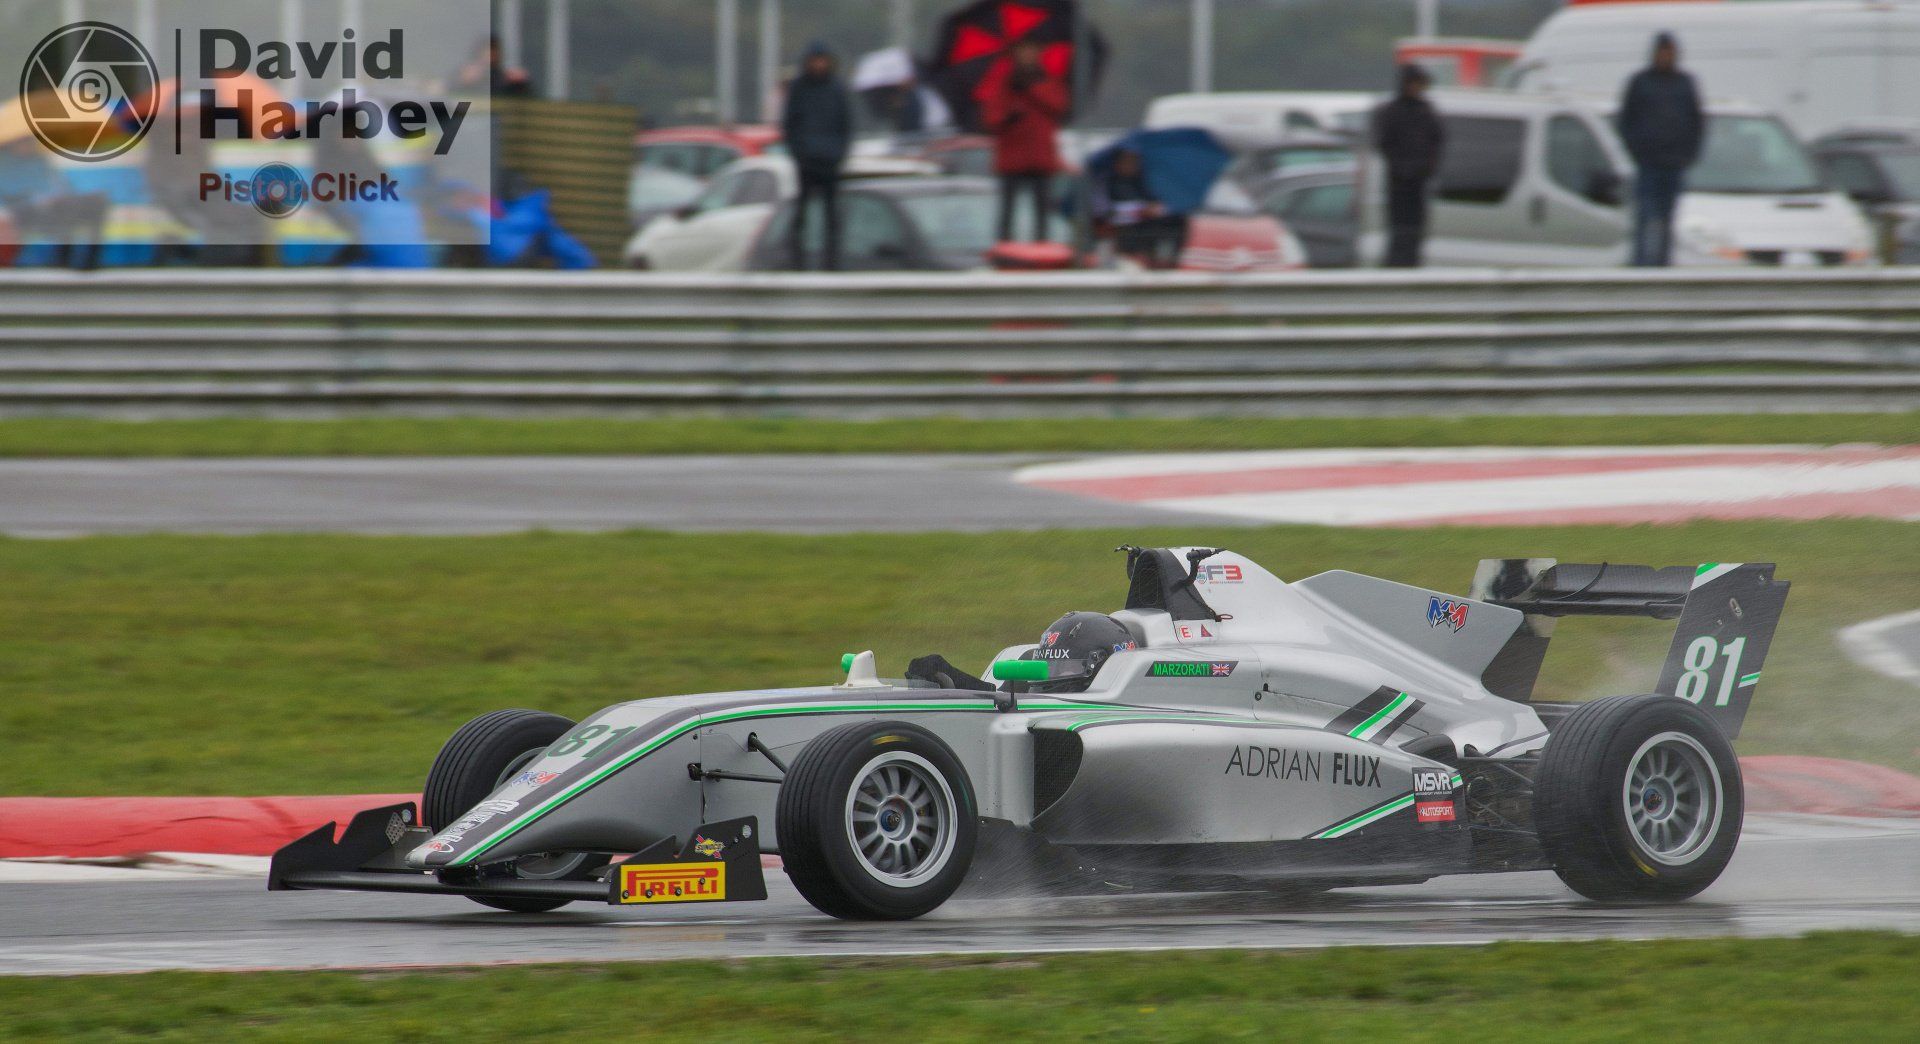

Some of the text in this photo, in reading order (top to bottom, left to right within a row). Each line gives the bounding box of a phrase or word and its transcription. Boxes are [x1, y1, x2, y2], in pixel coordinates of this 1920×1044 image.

[1044, 649, 1070, 659] FLUX
[1154, 663, 1210, 676] MARZORATI
[1674, 636, 1746, 706] 81
[547, 725, 637, 758] 81
[1225, 744, 1382, 788] ADRIAN FLUX
[1414, 772, 1452, 791] MSVR
[627, 868, 719, 897] PIRELLI
